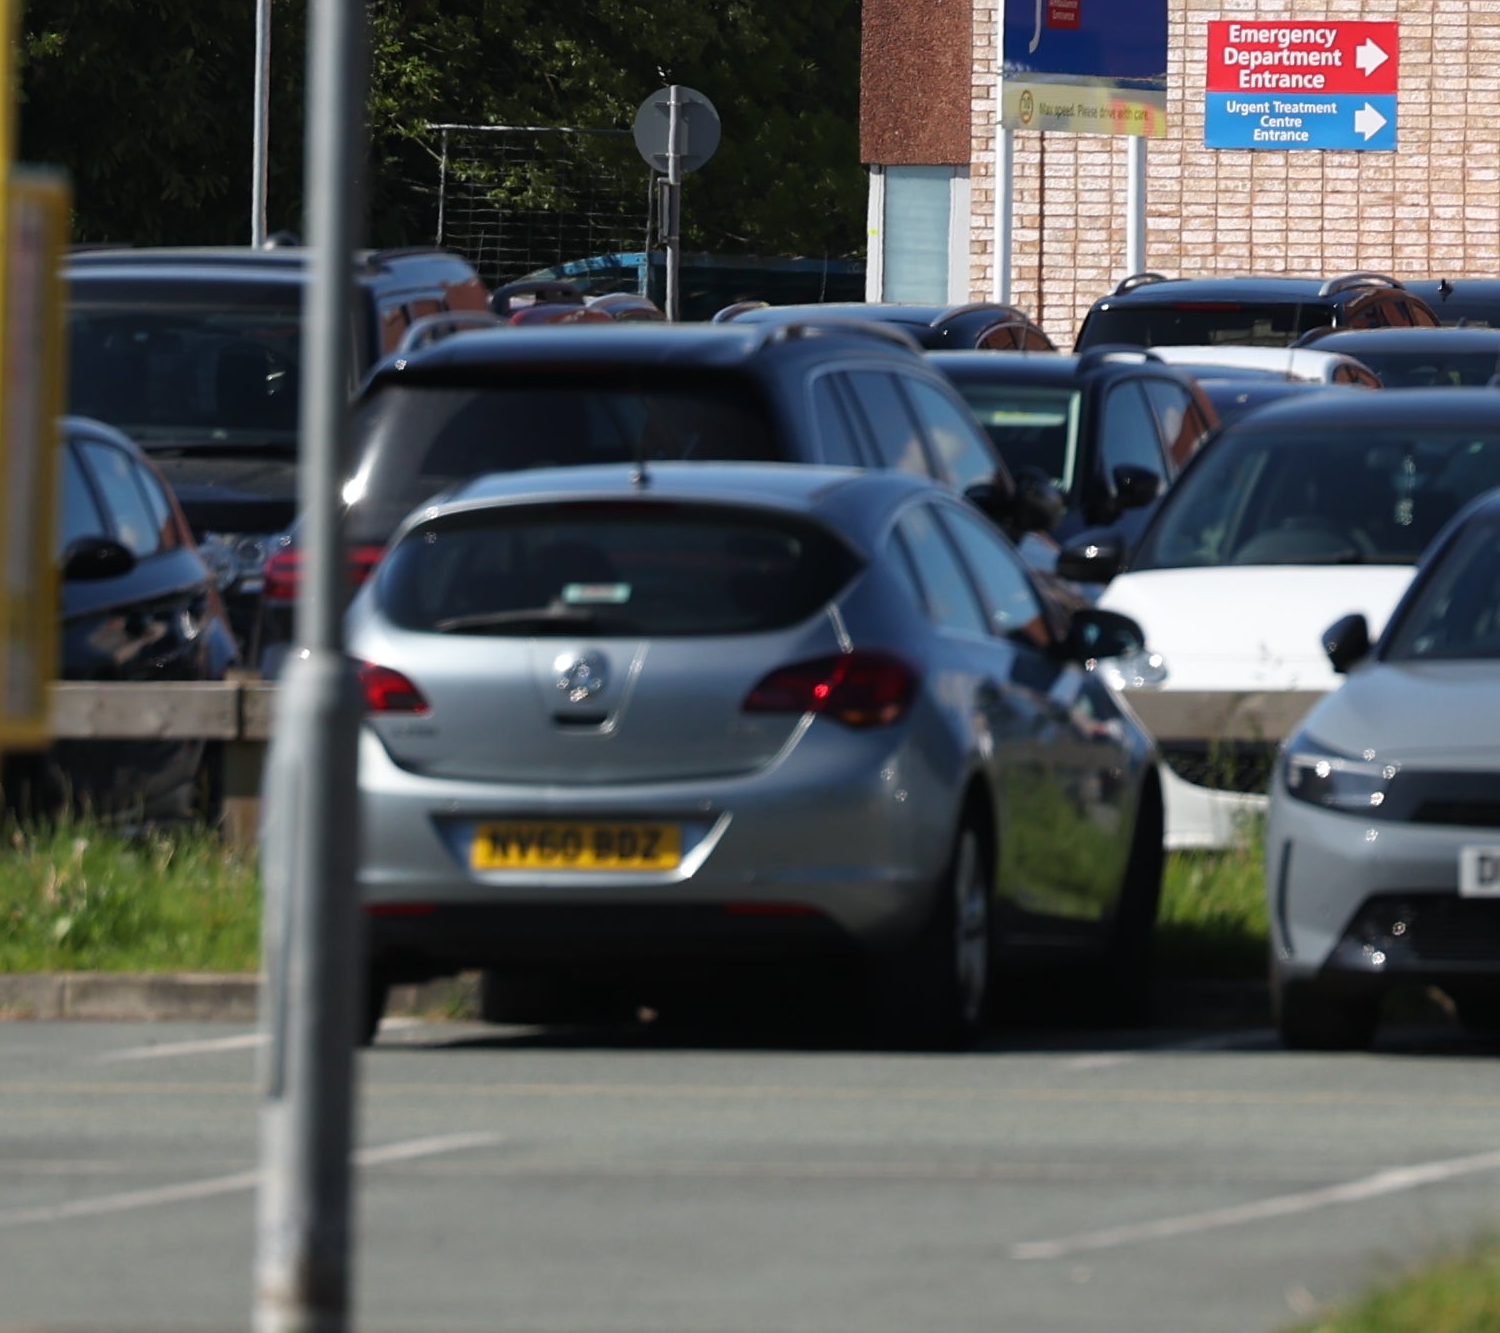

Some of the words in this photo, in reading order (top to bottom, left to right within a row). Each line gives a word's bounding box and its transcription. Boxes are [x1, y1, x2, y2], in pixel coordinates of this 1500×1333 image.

[1229, 24, 1337, 47] Emergency
[1223, 47, 1342, 69] Department
[1239, 69, 1325, 88] Entrance
[1226, 100, 1270, 115] Urgent
[1273, 100, 1337, 114] Treatment
[1260, 115, 1302, 127] Centre
[1253, 129, 1309, 142] Entrance
